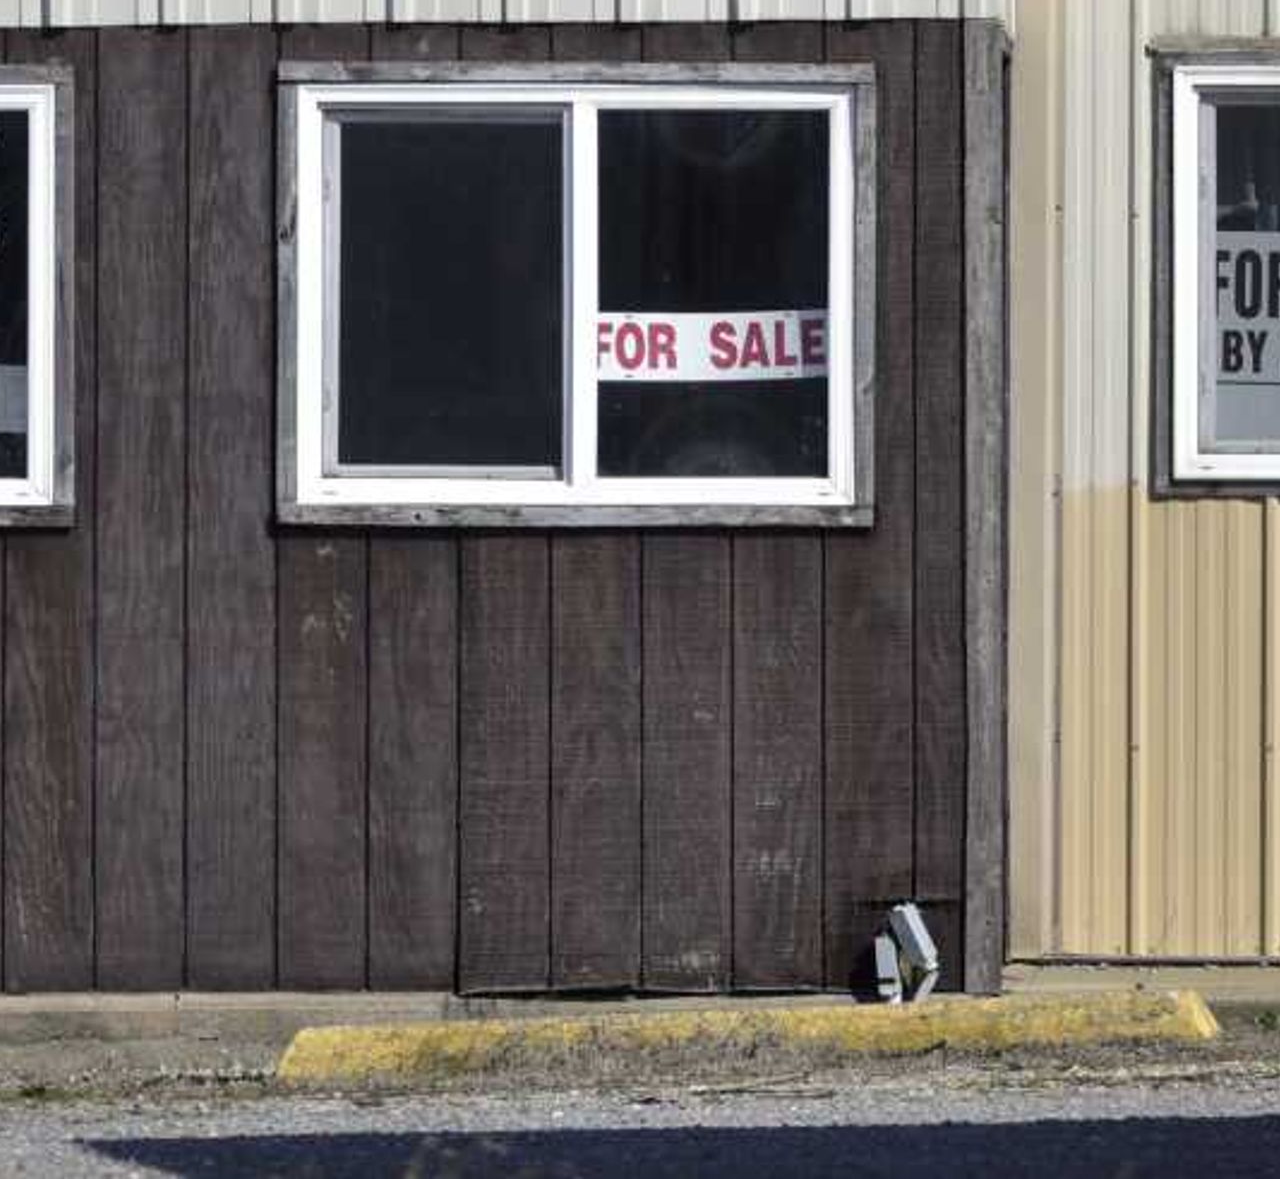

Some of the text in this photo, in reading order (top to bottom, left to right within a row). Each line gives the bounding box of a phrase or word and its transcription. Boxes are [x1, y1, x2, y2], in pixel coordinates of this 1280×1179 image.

[598, 319, 827, 369] FOR SALE
[1223, 330, 1267, 373] BY
